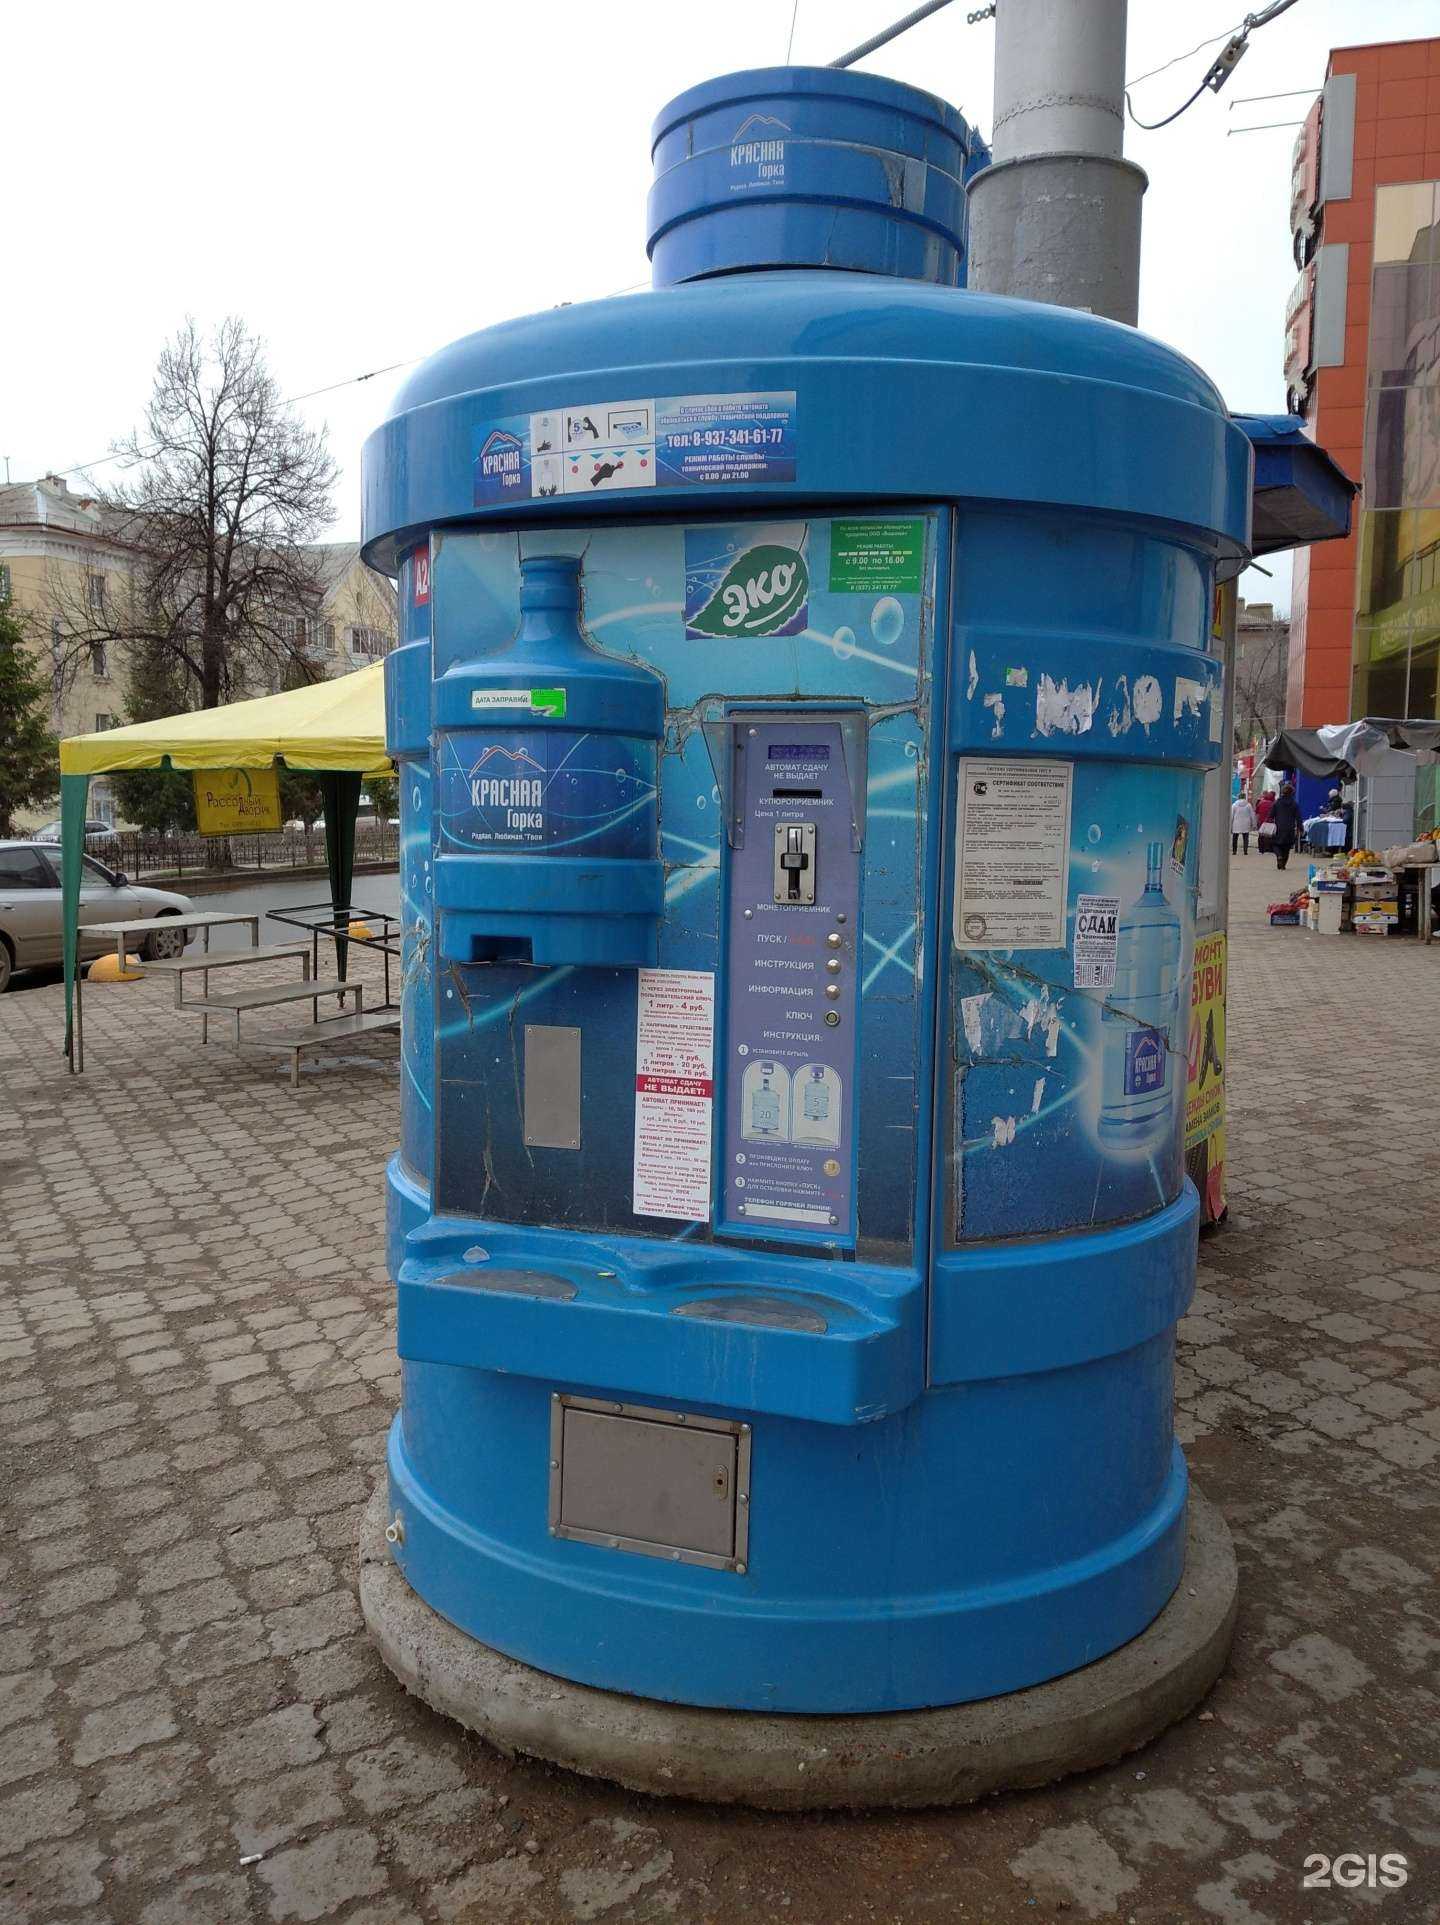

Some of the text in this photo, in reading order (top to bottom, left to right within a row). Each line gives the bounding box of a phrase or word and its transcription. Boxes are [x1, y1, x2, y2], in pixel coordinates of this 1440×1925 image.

[730, 140, 784, 167] КРАСНАЯ
[758, 162, 785, 180] Горка
[693, 427, 783, 447] 8-937-341-61-77
[483, 450, 520, 475] КРАСНАЯ
[685, 455, 708, 463] РЕЖИМ
[708, 454, 735, 462] РАБОТЫ
[502, 473, 521, 488] Горка
[475, 696, 528, 705] ДАТА ЗАПРАВКИ
[764, 763, 829, 772] АВТОМАТ СДАЧУ
[773, 772, 819, 781] НЕ ВЫДАЕТ
[471, 779, 542, 807] КРАСНАЯ
[759, 798, 834, 807] КУПЮРОПРИЕМНИК
[755, 810, 774, 818] Цена
[775, 810, 779, 818] 1
[507, 808, 543, 832] Горка
[756, 904, 831, 913] МОНЕТОПРИЕМНИК
[1078, 915, 1117, 934] СДАМ
[757, 934, 782, 943] ПУСК
[754, 959, 814, 970] ИНСТРУКЦИЯ
[748, 984, 814, 996] ИНФОРМАЦИЯ
[656, 1002, 674, 1010] литр
[690, 1004, 705, 1012] руб.
[785, 1010, 813, 1021] КЛЮЧ
[763, 1030, 823, 1042] ИНСТРУКЦИЯ:
[752, 1048, 786, 1056] УСТАНОВИТЕ
[652, 1067, 676, 1075] литров
[660, 1086, 705, 1095] ВЫДАЕТ!
[642, 1097, 669, 1105] АВТОМАТ
[749, 1153, 787, 1163] ПРОИЗВЕДИТЕ
[759, 1161, 796, 1171] ПРИСЛОНИТЕ
[747, 1178, 775, 1186] НАЖМИТЕ
[744, 1197, 775, 1206] ТЕЛЕФОН
[775, 1200, 805, 1209] ГОРЯЧЕЙ
